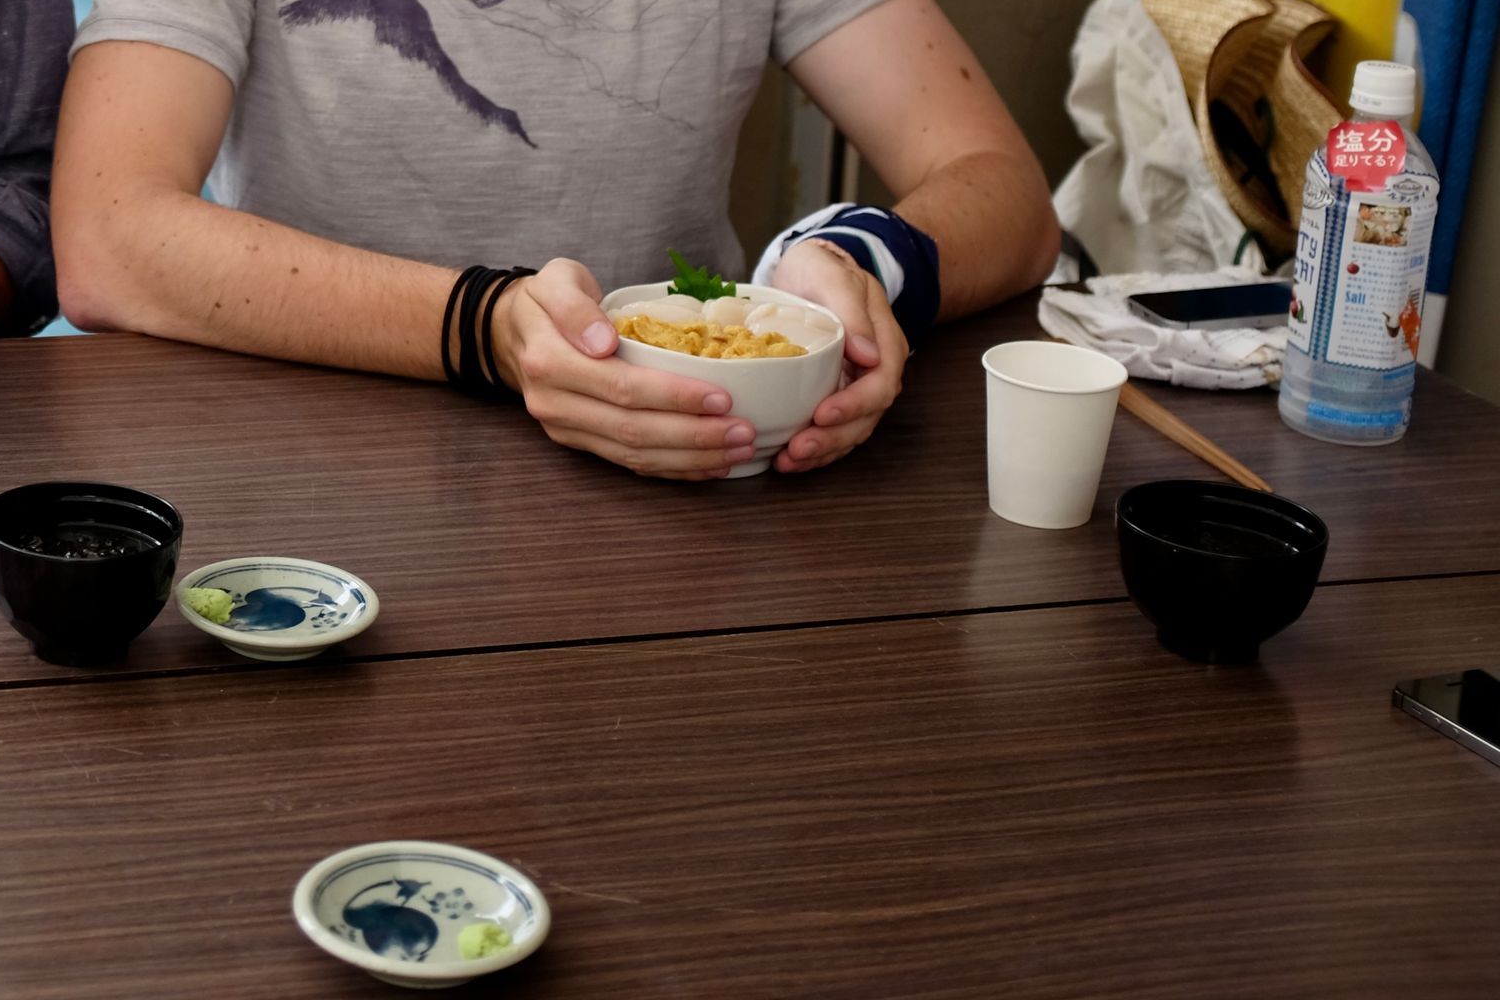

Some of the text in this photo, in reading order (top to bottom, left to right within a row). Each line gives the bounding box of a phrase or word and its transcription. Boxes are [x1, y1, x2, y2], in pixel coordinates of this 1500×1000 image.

[1335, 128, 1398, 153] 塩分
[1334, 154, 1396, 167] 足りてる?
[1344, 290, 1367, 306] Salt
